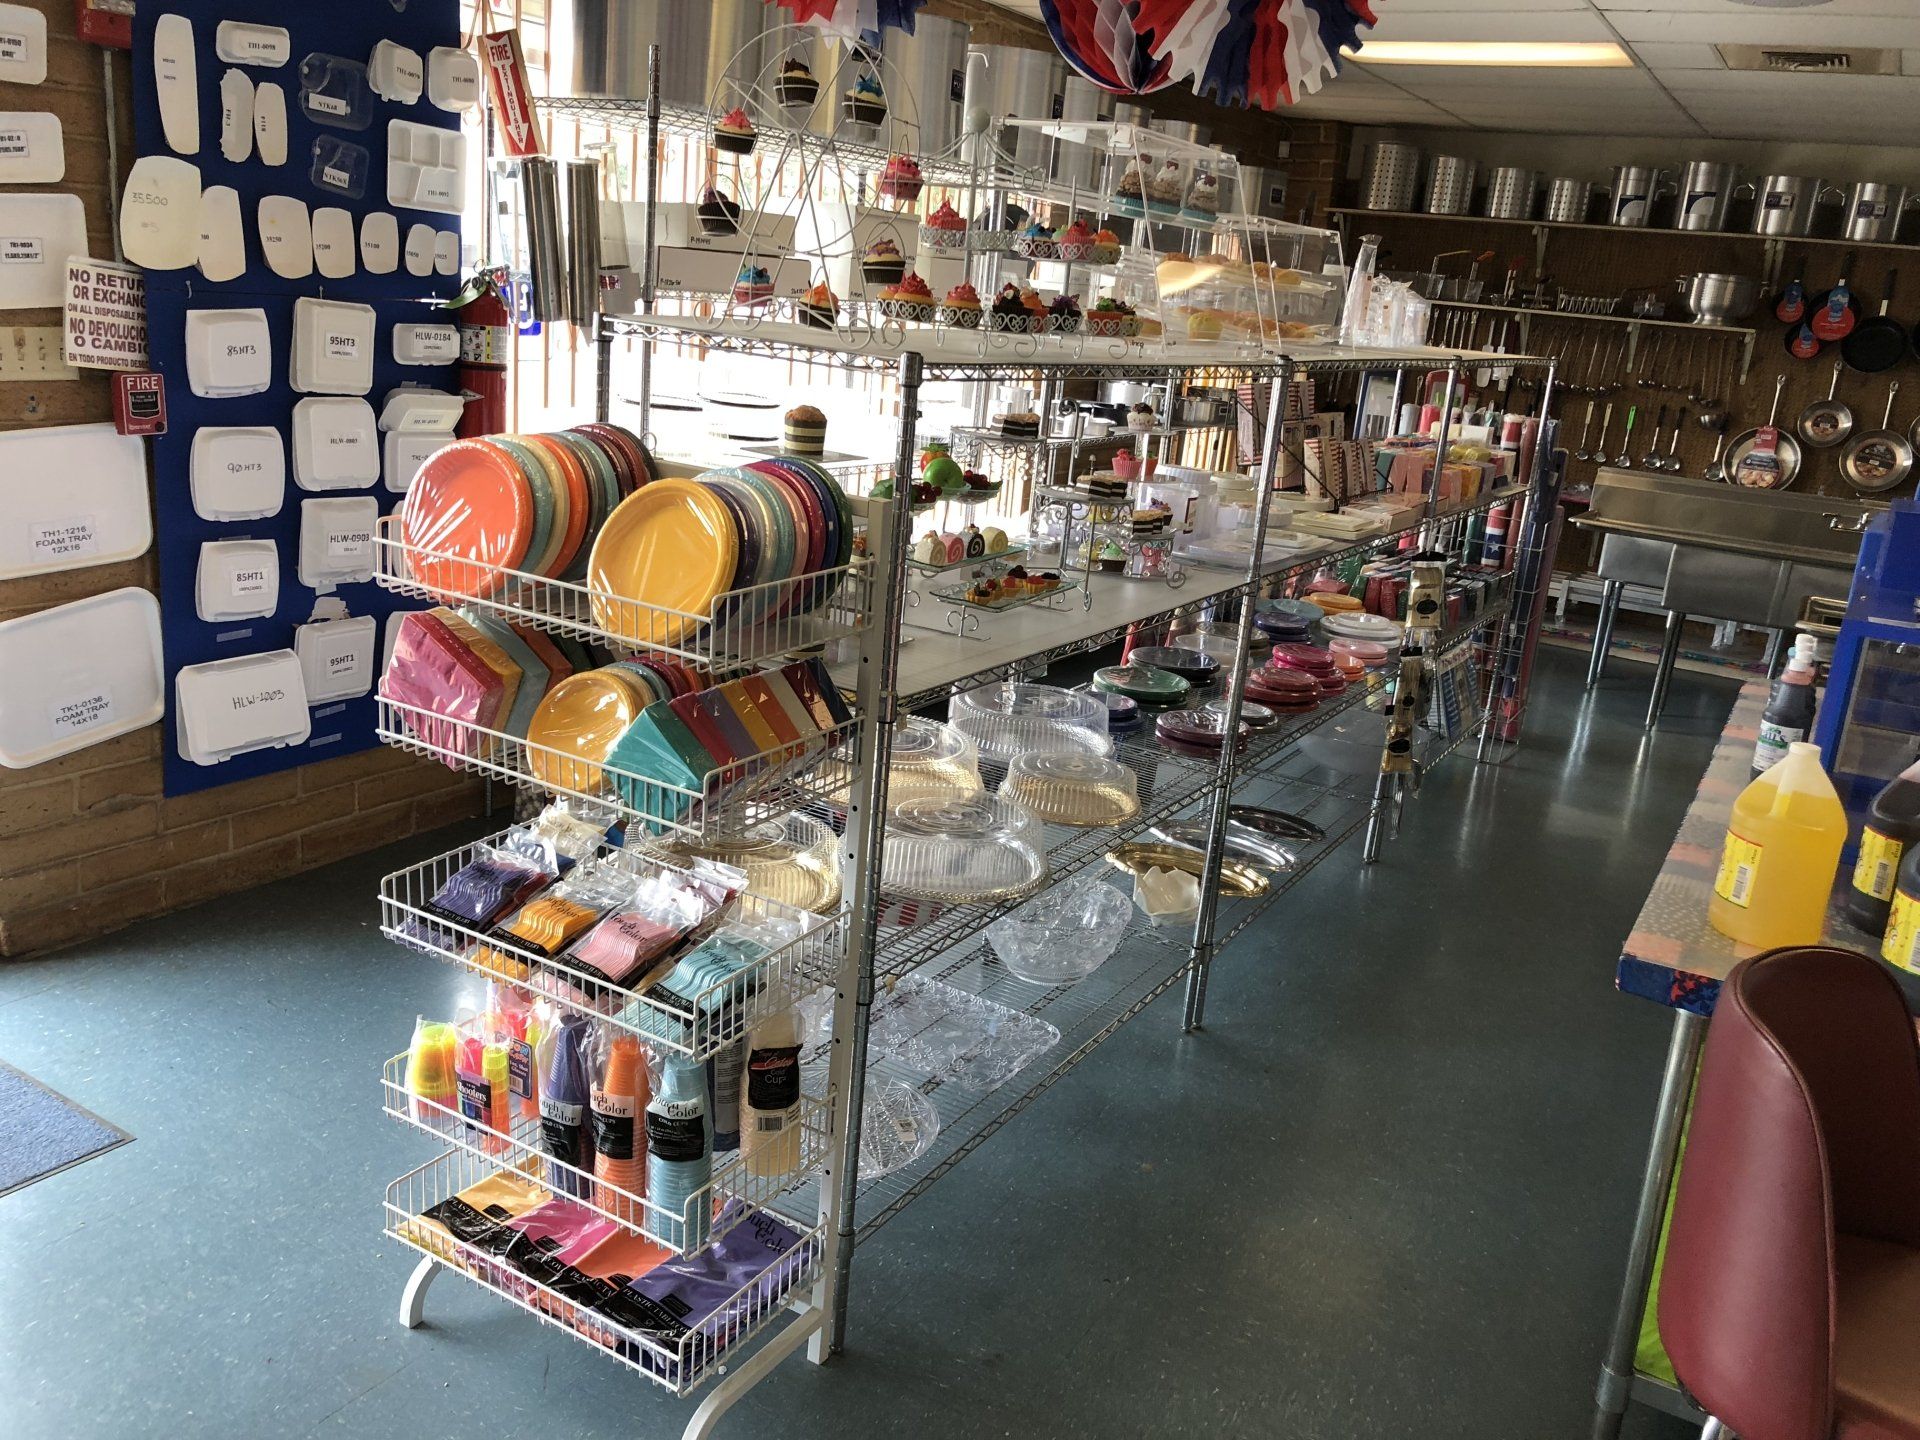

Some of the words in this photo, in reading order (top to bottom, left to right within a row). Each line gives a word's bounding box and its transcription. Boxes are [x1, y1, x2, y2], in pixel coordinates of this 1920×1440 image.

[489, 43, 511, 61] FIRE
[501, 63, 524, 143] EXTINGUISHER
[132, 192, 168, 206] 35500
[69, 268, 91, 283] NO
[73, 284, 89, 300] OR
[67, 303, 78, 312] ON
[79, 305, 93, 315] ALL
[94, 306, 136, 321] DISPOSABLE
[69, 317, 85, 334] NO
[73, 335, 86, 347] O
[329, 336, 356, 347] 95HT3
[415, 331, 451, 342] HLW-0184
[226, 345, 257, 357] 85HT3
[68, 352, 78, 361] EN
[79, 354, 95, 364] TODO
[96, 355, 129, 368] PRODUCTO
[126, 376, 159, 390] FIRE
[41, 525, 87, 539] TH1-1216
[330, 533, 370, 544] HLW-0903
[35, 537, 66, 548] FOAM
[67, 533, 93, 543] TRAY
[51, 543, 81, 554] 12X16
[236, 571, 264, 582] 85HT1
[329, 653, 355, 667] 95HT1
[60, 695, 103, 714] TK1-0136
[55, 710, 84, 725] FOAM
[84, 701, 110, 714] TRAY
[71, 713, 99, 727] 14X18
[609, 911, 637, 930] Touch
[619, 924, 649, 943] Color
[456, 1081, 487, 1102] Shooters
[598, 1100, 628, 1115] Color
[667, 1106, 699, 1118] Color
[548, 1108, 577, 1124] Color
[622, 1288, 653, 1310] PLASTIC
